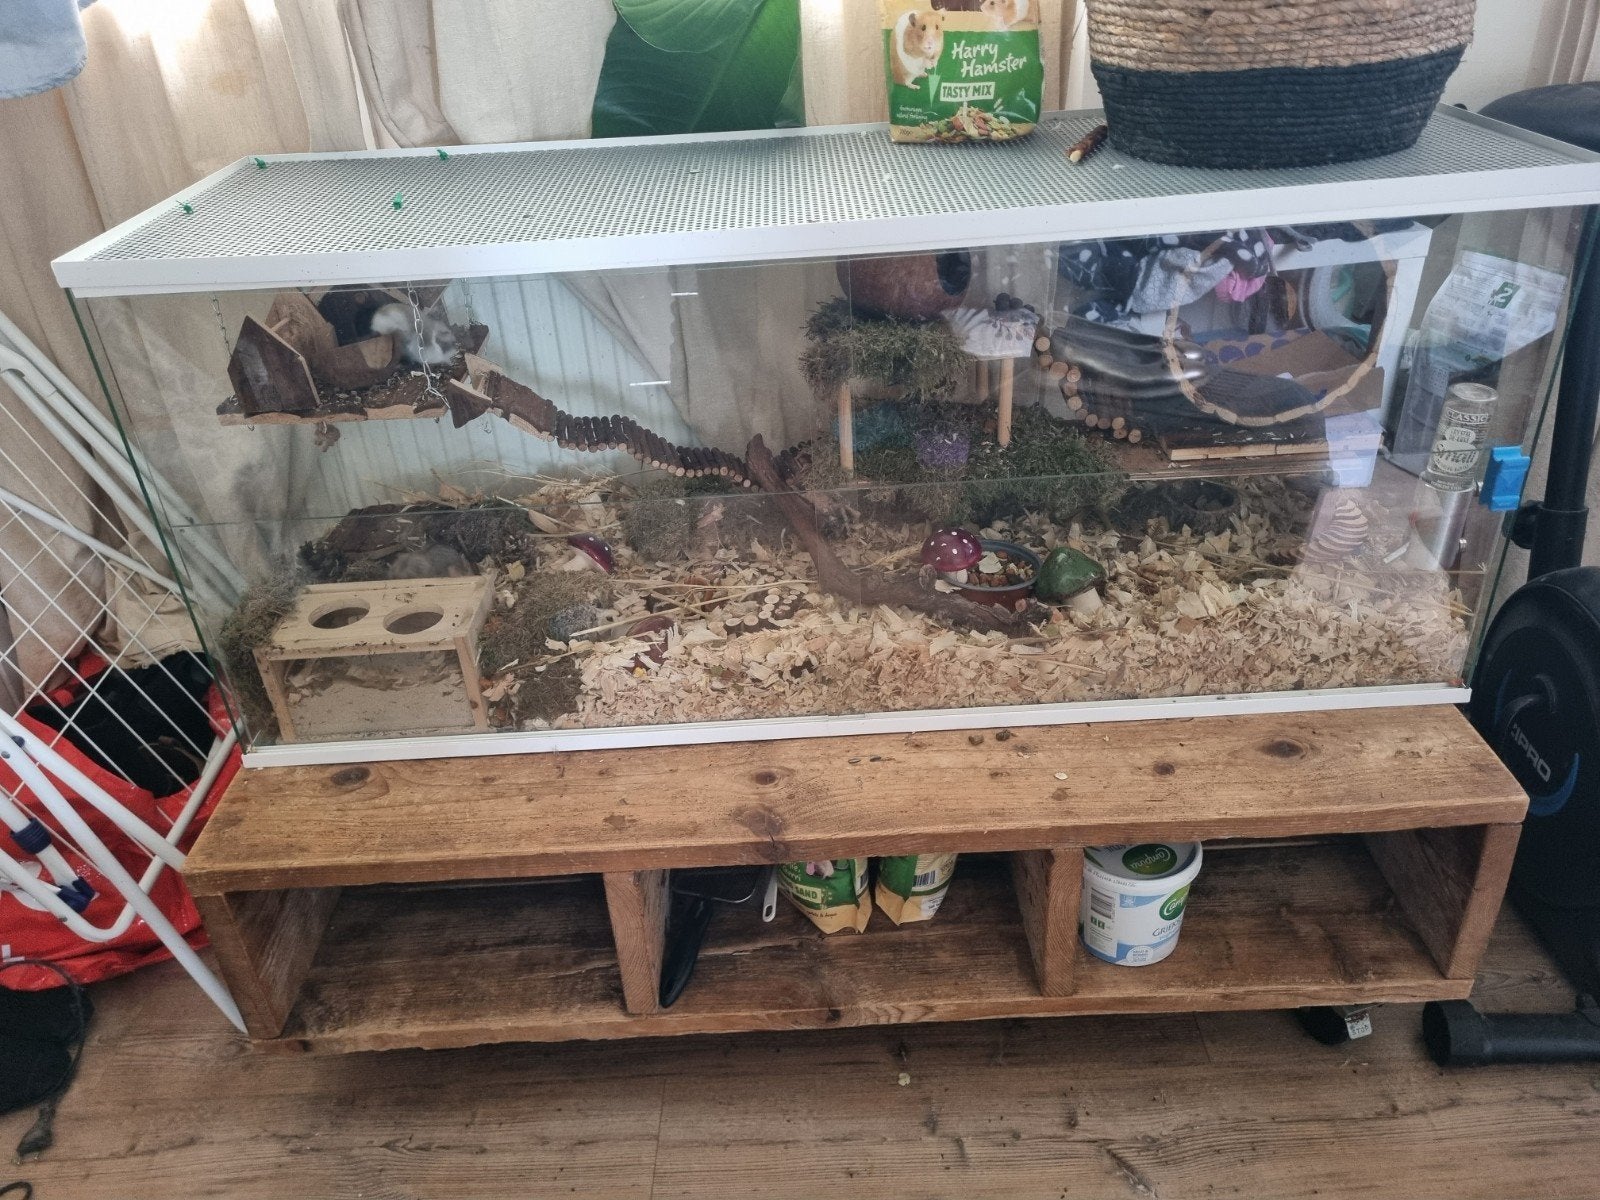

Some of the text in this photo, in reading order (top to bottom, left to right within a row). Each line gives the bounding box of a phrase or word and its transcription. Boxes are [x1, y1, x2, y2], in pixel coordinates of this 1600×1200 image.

[952, 40, 998, 63] Harry
[961, 53, 1027, 78] Hamster
[942, 83, 993, 99] TASTY MIX
[1131, 847, 1171, 869] Campina
[1352, 1024, 1369, 1035] STOP
